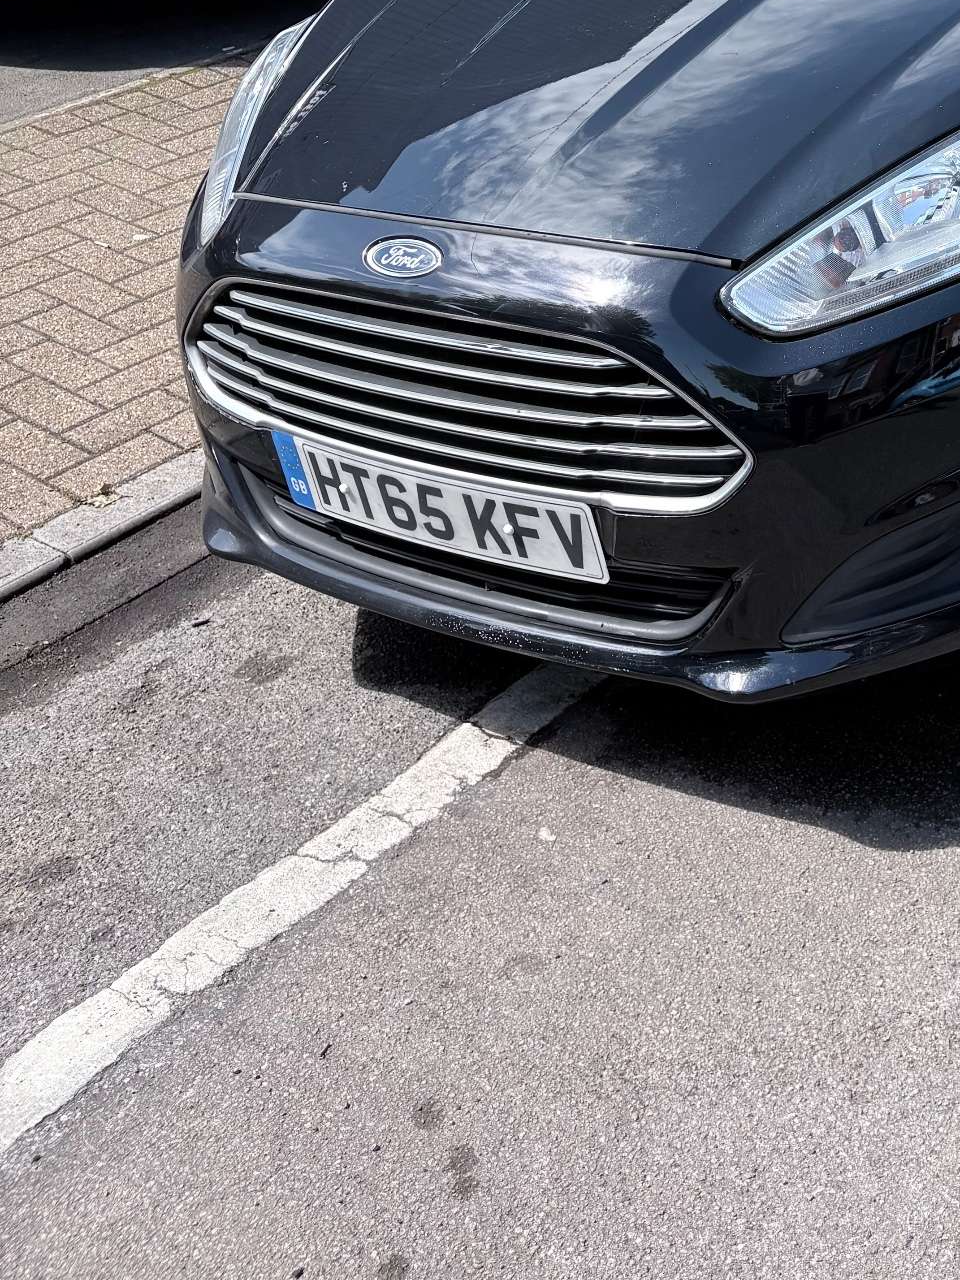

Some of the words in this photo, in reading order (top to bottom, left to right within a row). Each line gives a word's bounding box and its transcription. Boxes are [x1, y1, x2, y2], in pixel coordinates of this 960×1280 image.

[380, 245, 422, 269] Ford
[289, 476, 308, 495] GB
[308, 451, 455, 541] HT65
[462, 493, 585, 569] KFV
